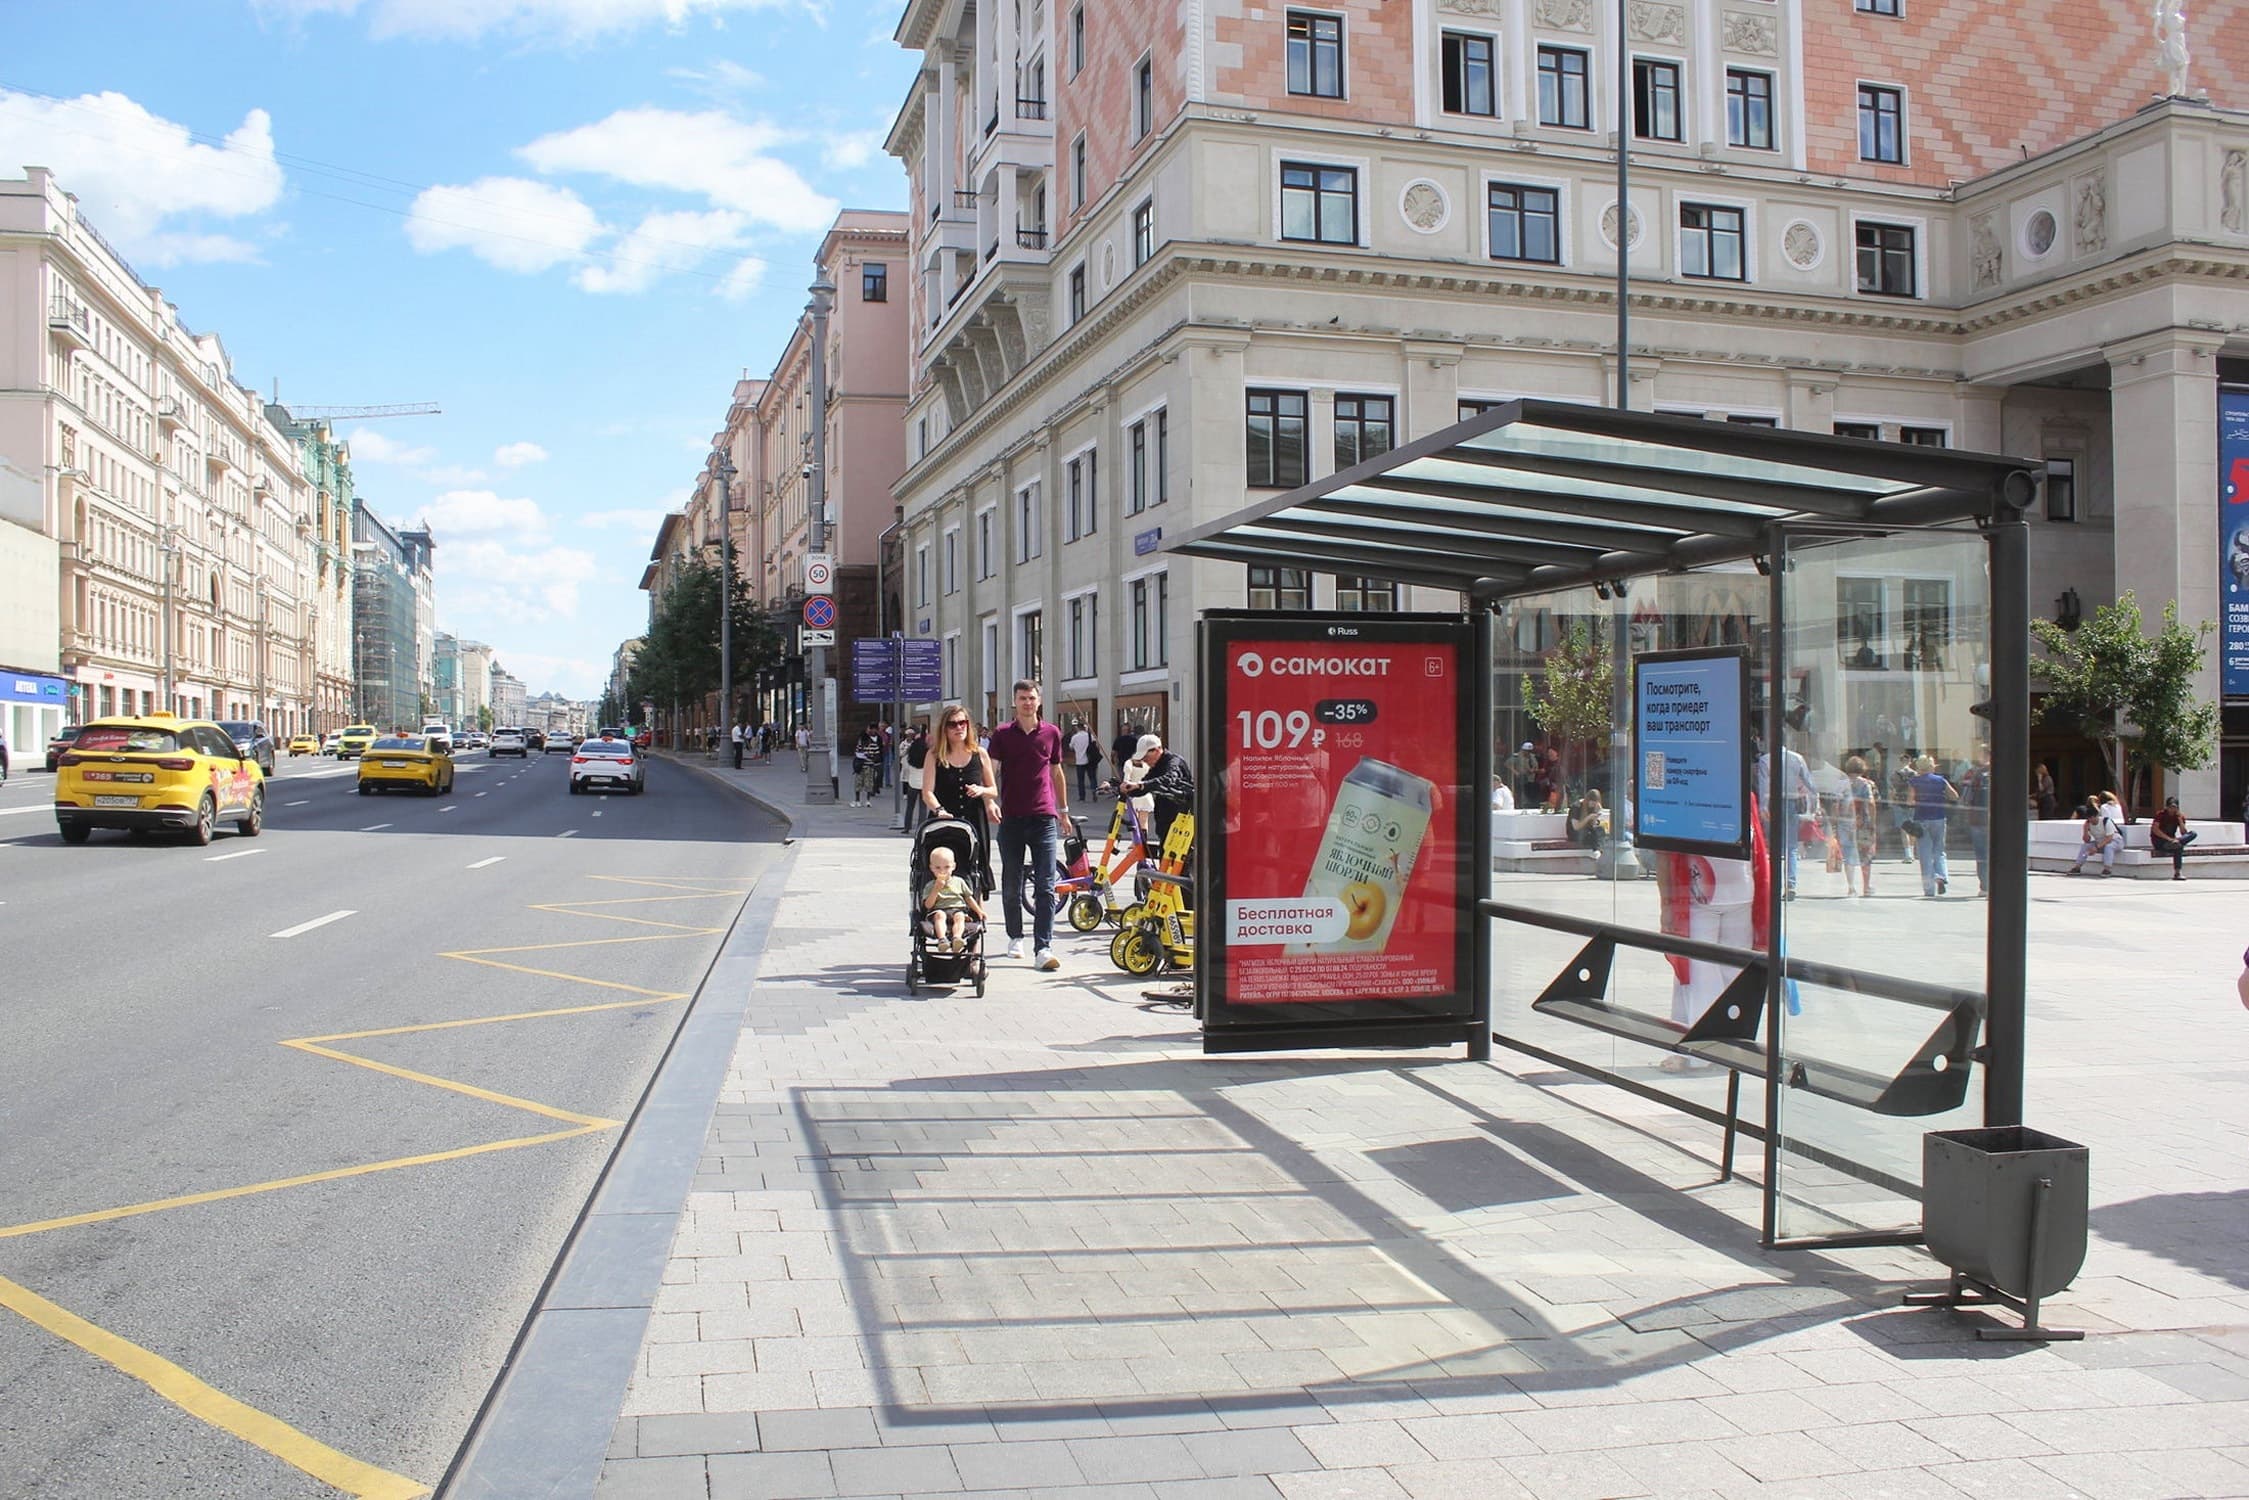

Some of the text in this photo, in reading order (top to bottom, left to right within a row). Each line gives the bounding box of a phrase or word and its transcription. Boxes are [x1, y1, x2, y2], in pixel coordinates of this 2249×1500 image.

[813, 569, 825, 578] 50
[2229, 603, 2249, 612] БАМ
[1337, 627, 1359, 636] Russ
[2228, 641, 2244, 651] 280
[1270, 657, 1391, 676] самокат
[1646, 682, 1702, 698] Посмотрите,
[1324, 704, 1368, 720] -35%
[1646, 702, 1709, 716] когда приедет
[1647, 720, 1711, 735] ваш транспорт
[1335, 732, 1364, 748] 168
[1329, 847, 1394, 880] ЯБЛОЧНЫЙ
[1325, 860, 1369, 885] ШОРЛИ
[1238, 907, 1334, 920] Бесплатная
[1237, 924, 1313, 938] доставка
